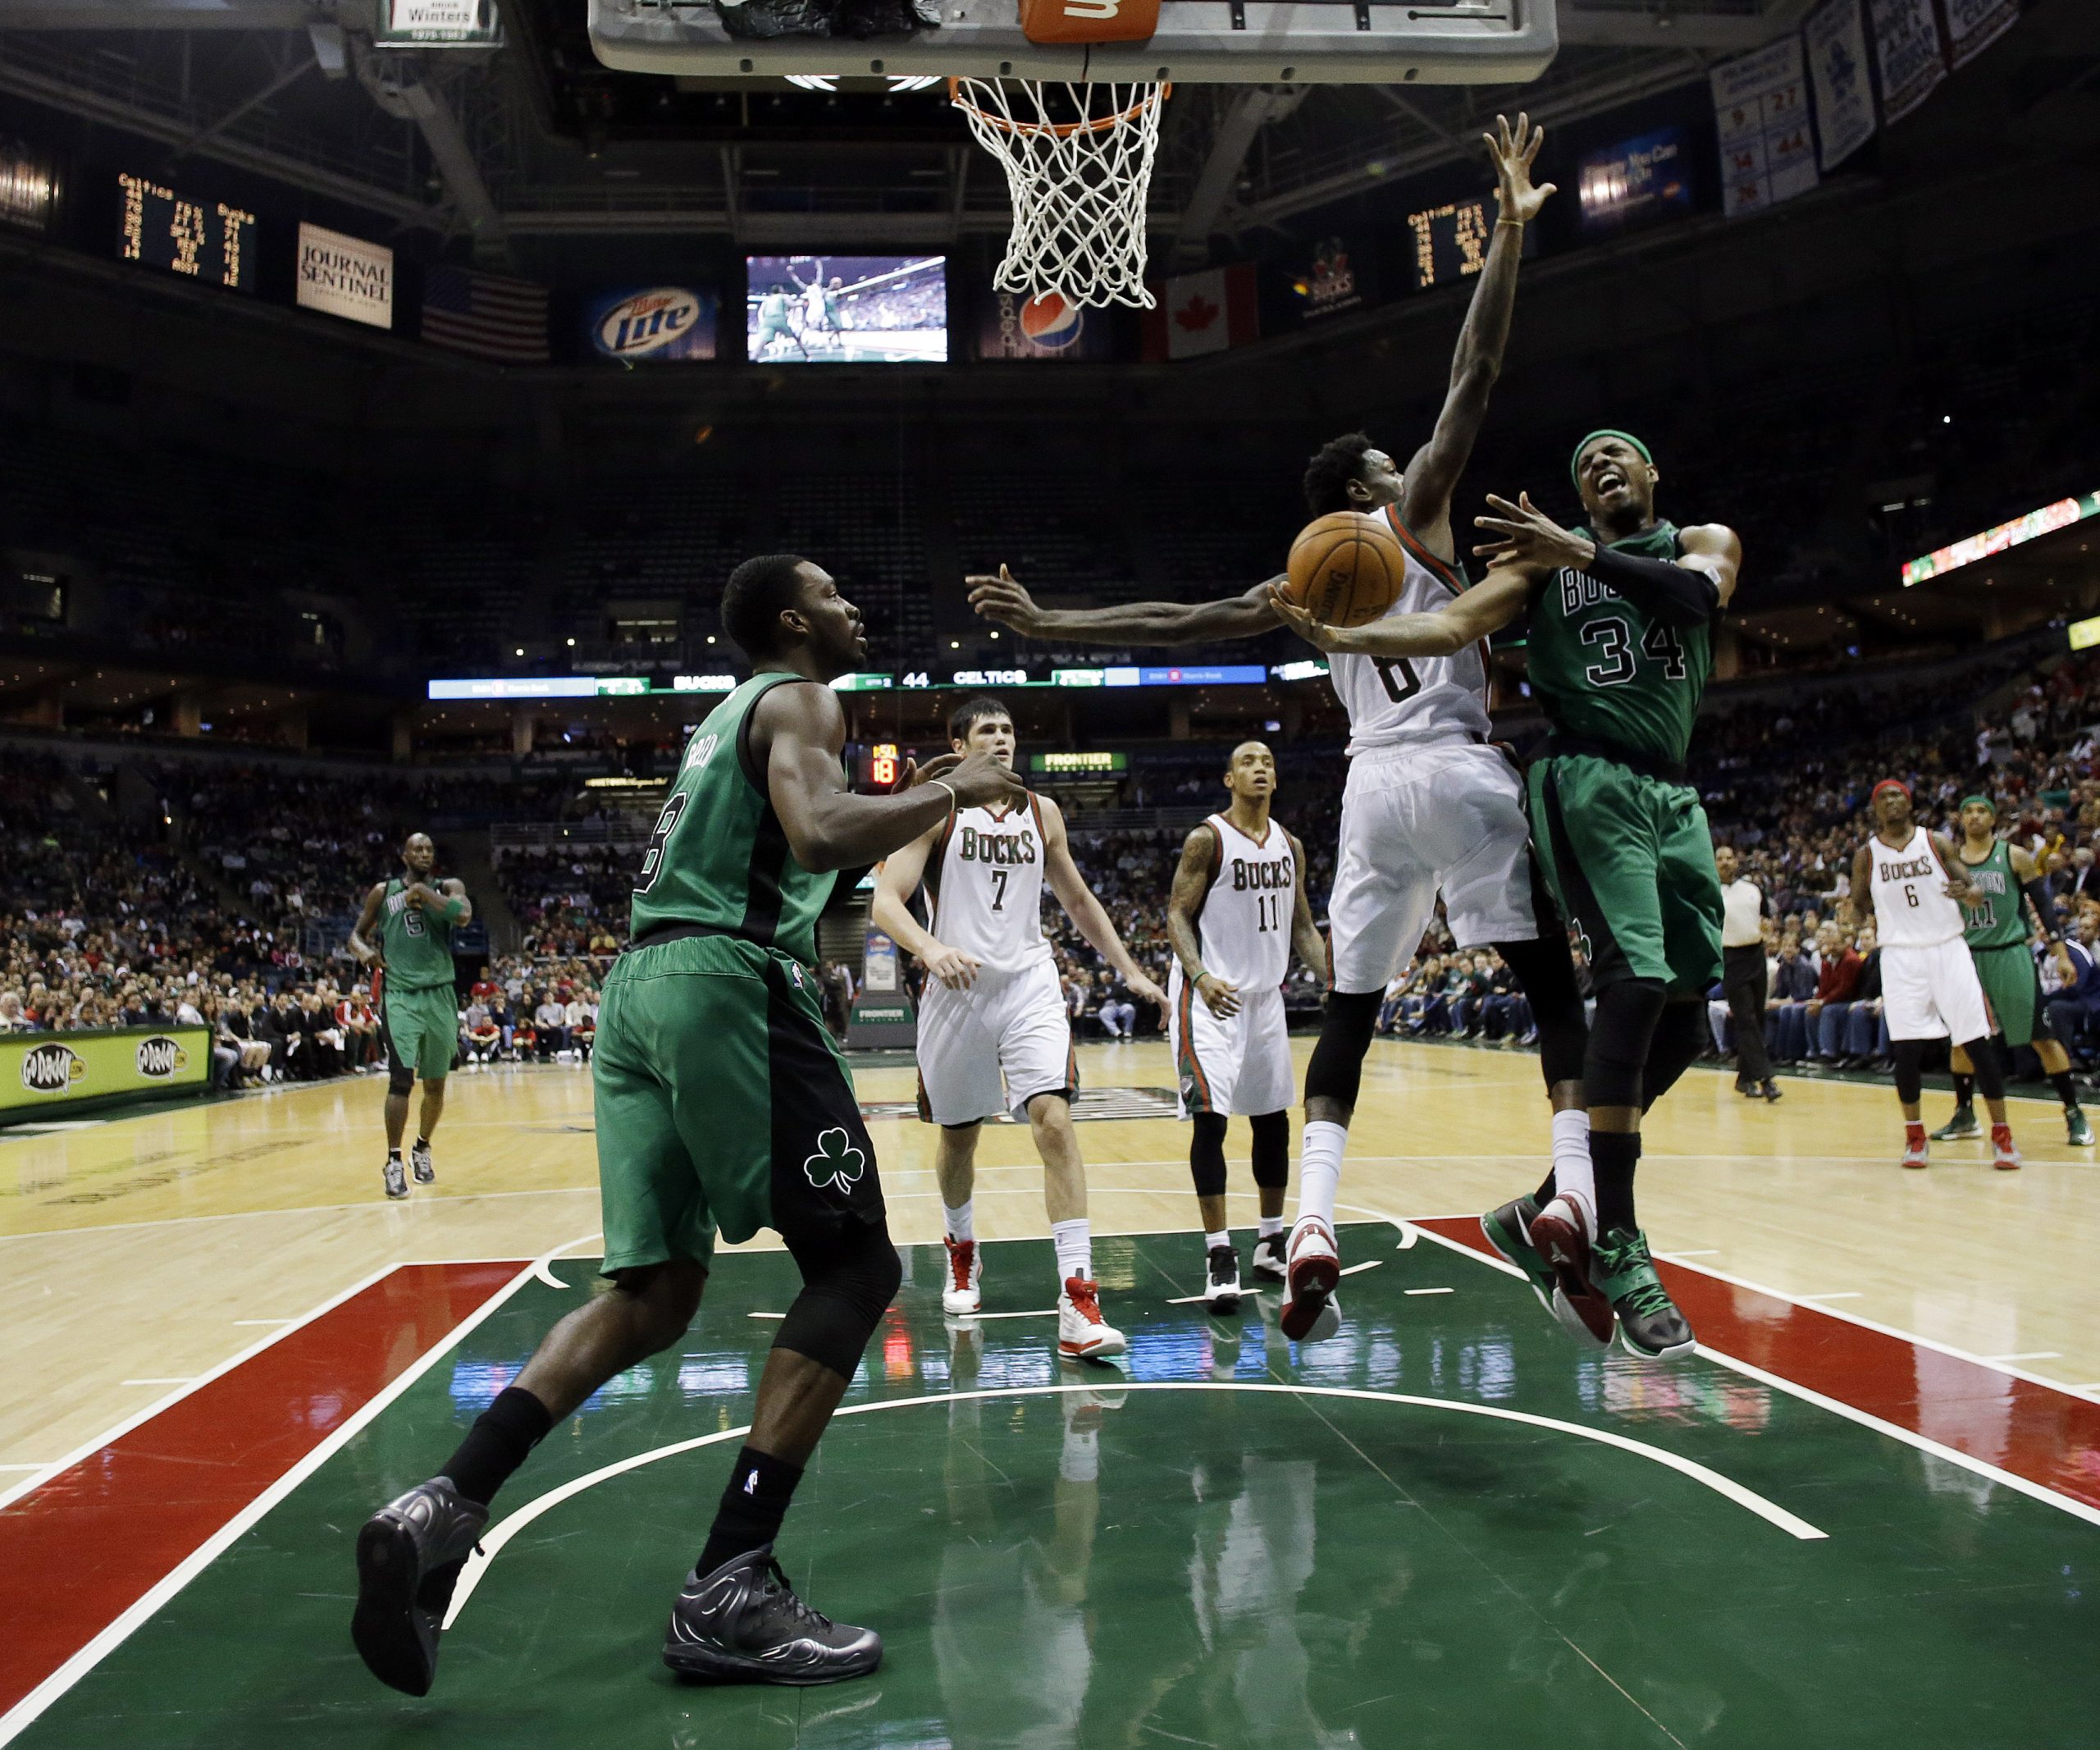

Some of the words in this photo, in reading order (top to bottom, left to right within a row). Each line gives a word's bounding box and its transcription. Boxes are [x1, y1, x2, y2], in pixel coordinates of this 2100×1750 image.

[409, 7, 471, 21] Winters
[302, 245, 390, 286] JOURNAL
[301, 262, 390, 303] SENTINEL
[615, 304, 691, 351] Lite
[1580, 616, 1686, 687] 34
[673, 675, 737, 691] BUCKS
[902, 672, 929, 688] 44
[953, 669, 1027, 685] CELTICS
[873, 759, 894, 784] 18
[1044, 752, 1112, 765] FRONTIER
[960, 827, 1035, 864] BUCKS
[1231, 857, 1291, 891] BUCKS
[1880, 856, 1933, 882] BUCKS
[991, 870, 1008, 911] 7
[1904, 884, 1920, 907] 6
[404, 910, 425, 938] 5
[1258, 894, 1279, 933] 11
[1970, 898, 1997, 929] 11
